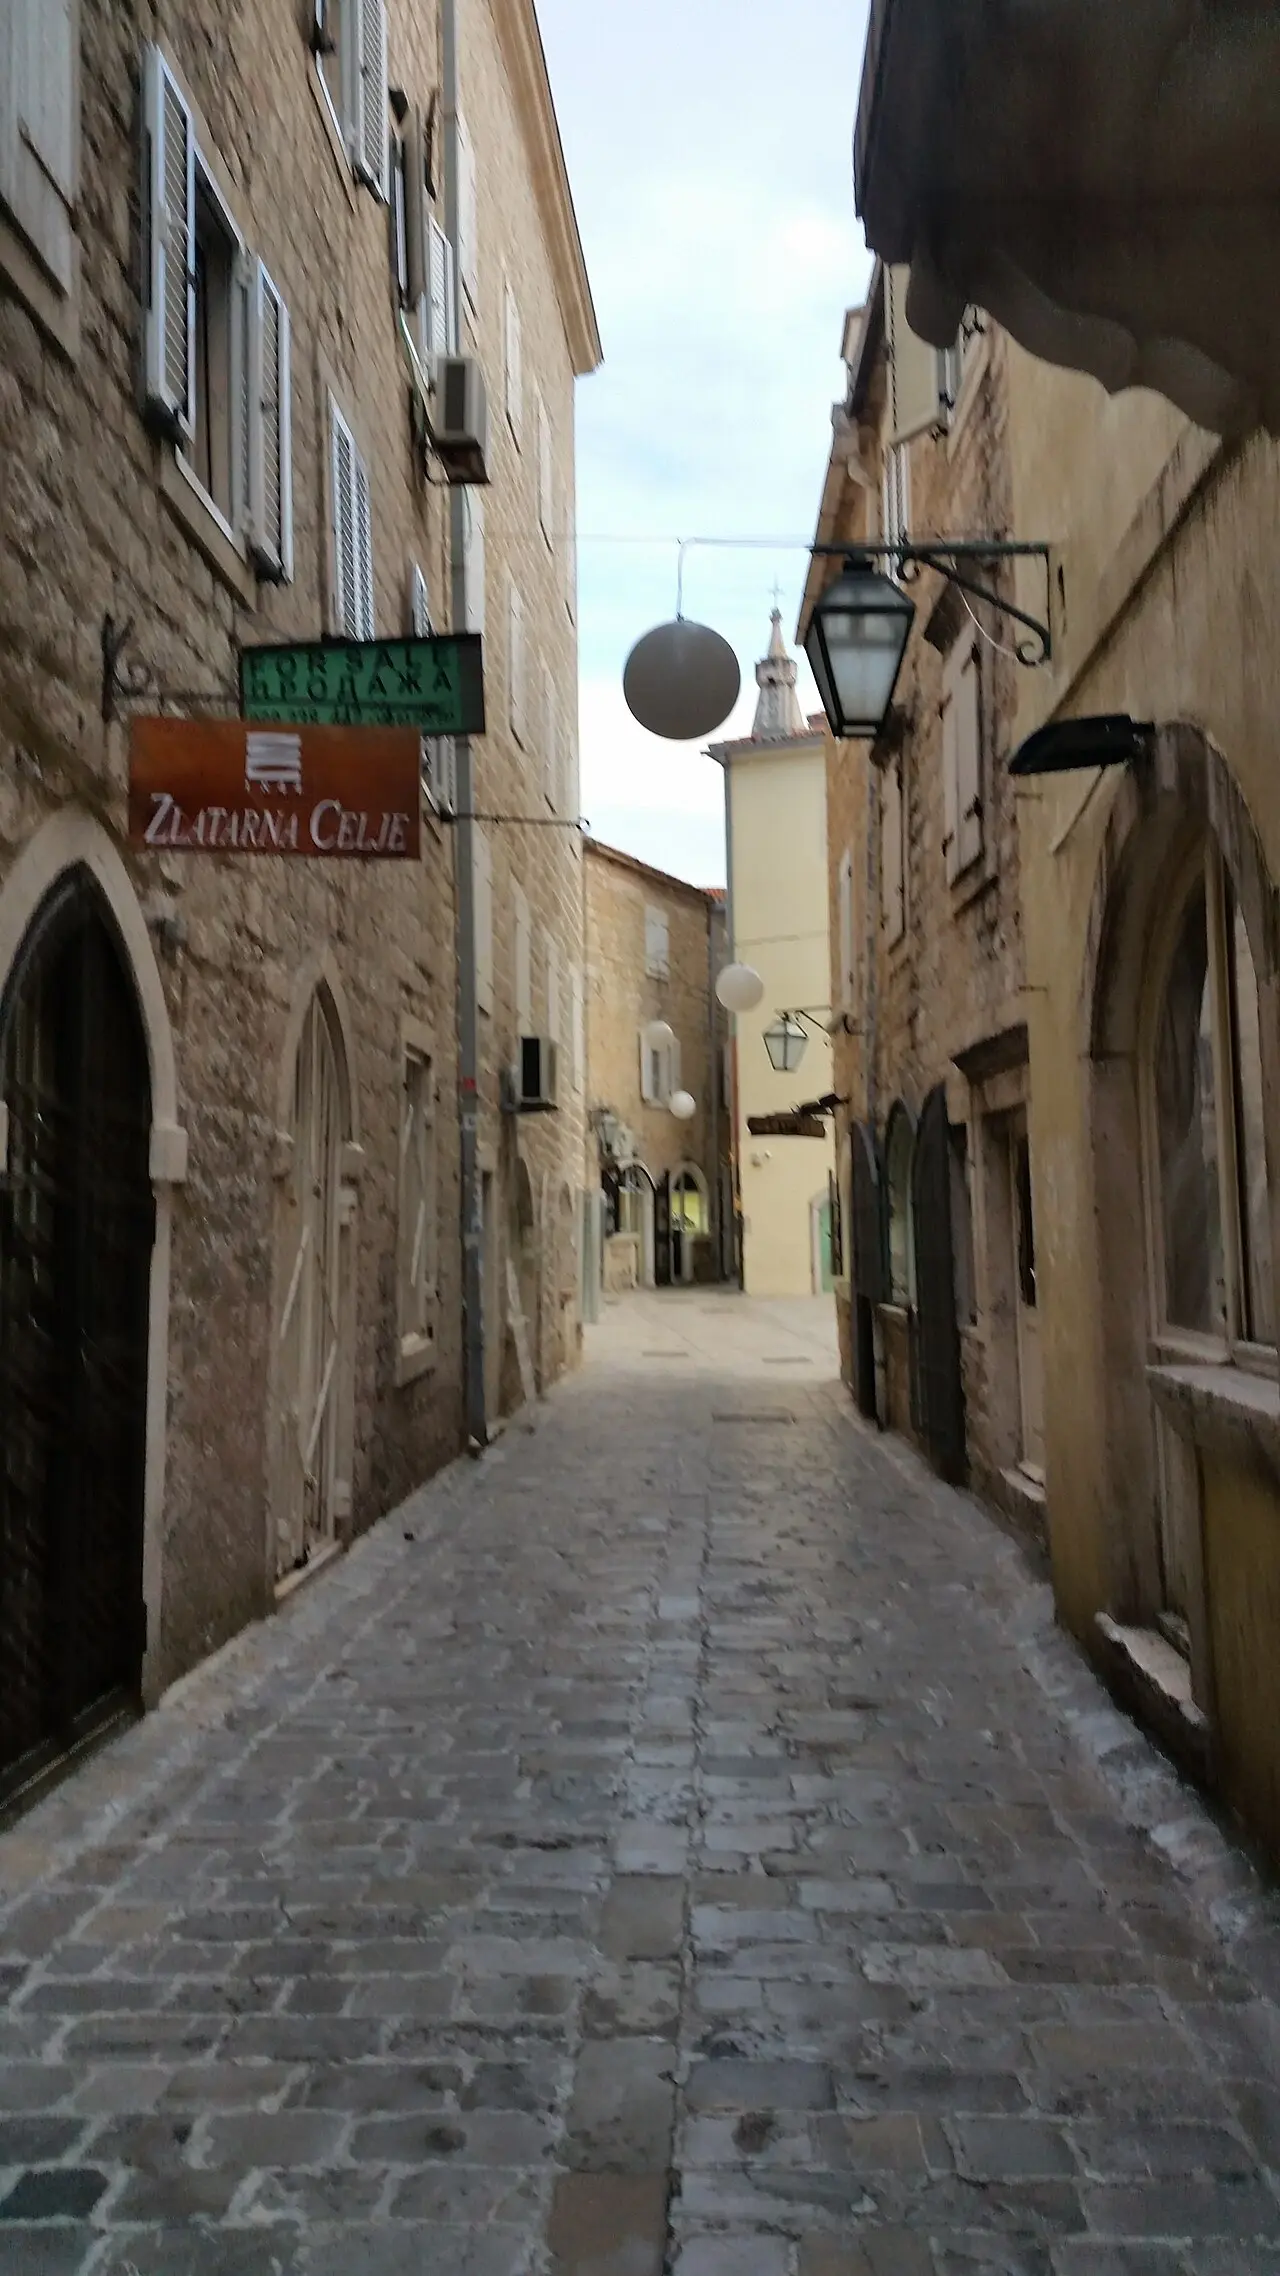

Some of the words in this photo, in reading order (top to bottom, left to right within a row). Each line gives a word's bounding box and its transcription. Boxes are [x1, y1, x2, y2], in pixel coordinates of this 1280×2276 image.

[250, 650, 327, 678] FOR
[345, 645, 453, 671] SALE
[143, 792, 299, 850] ZLATARNA
[309, 798, 410, 851] CELJE
